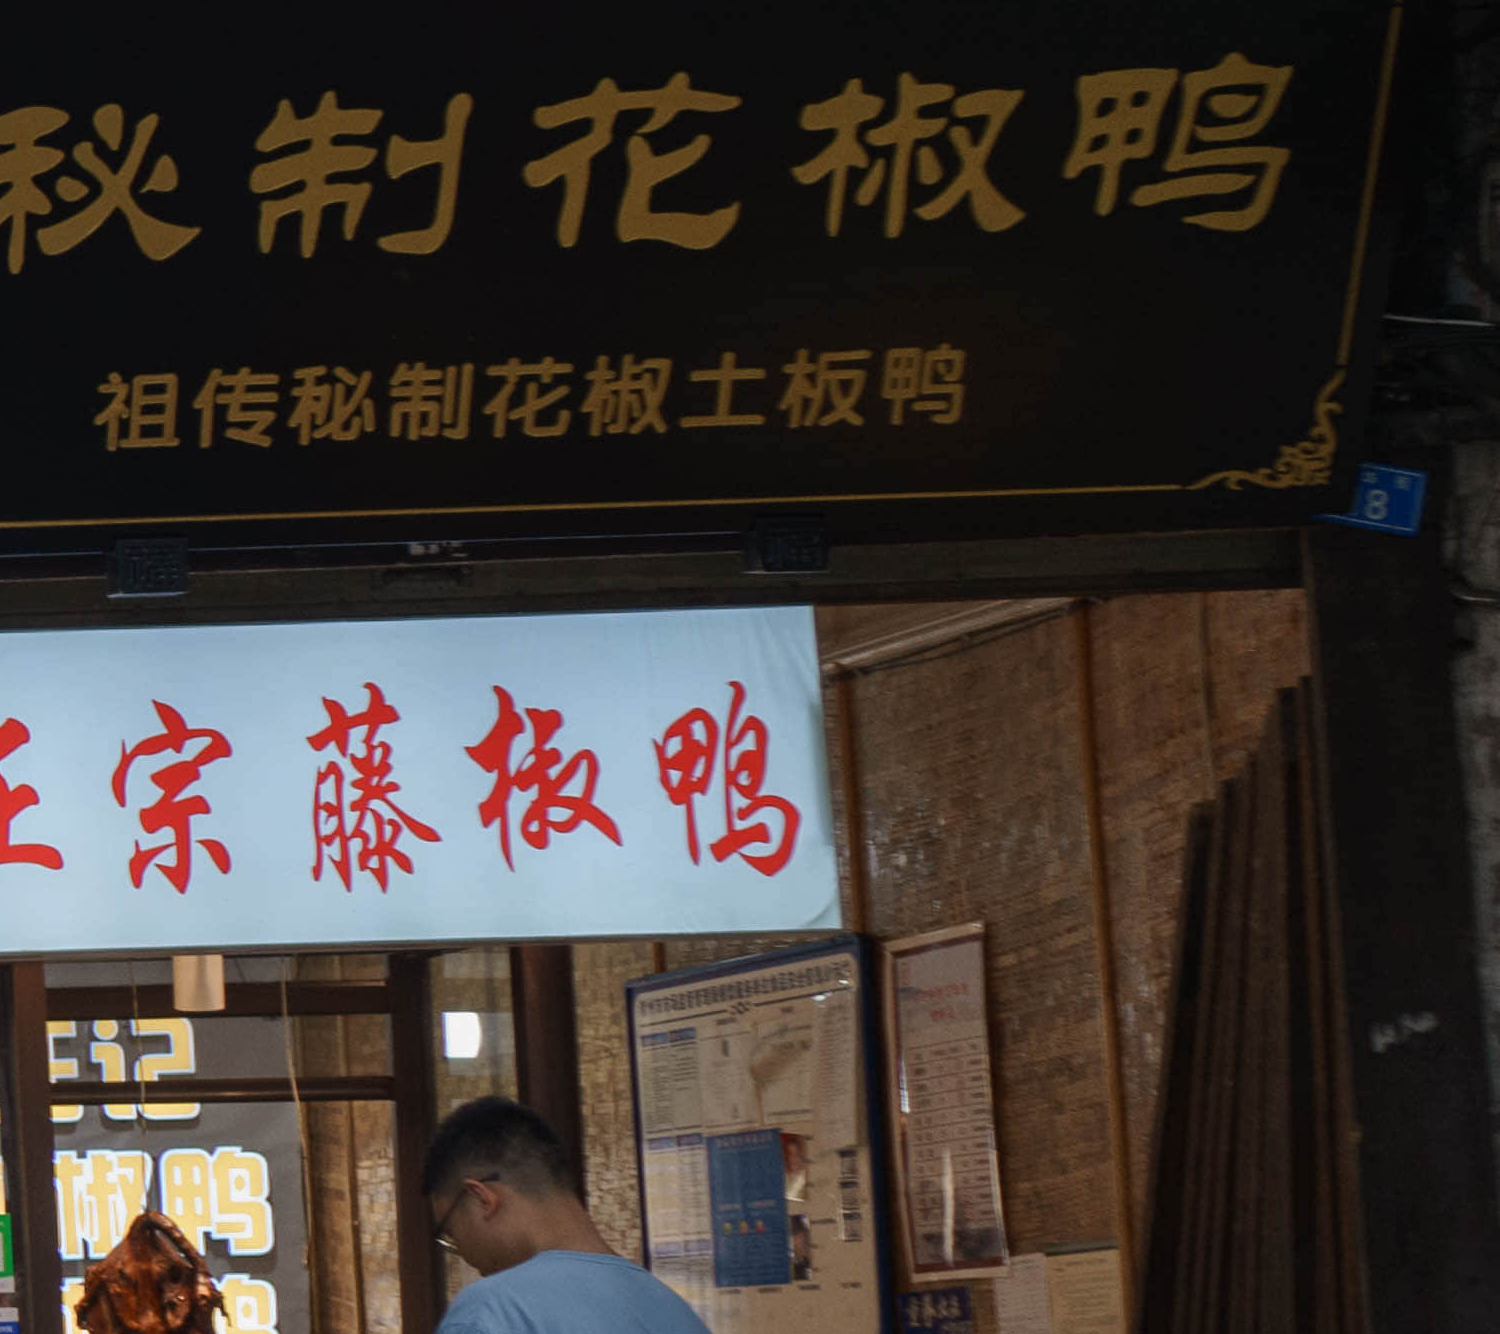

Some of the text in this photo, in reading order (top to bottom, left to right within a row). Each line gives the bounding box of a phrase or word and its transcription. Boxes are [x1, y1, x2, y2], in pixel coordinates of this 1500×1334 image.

[93, 342, 967, 451] 祖传秘制花椒土板鸭
